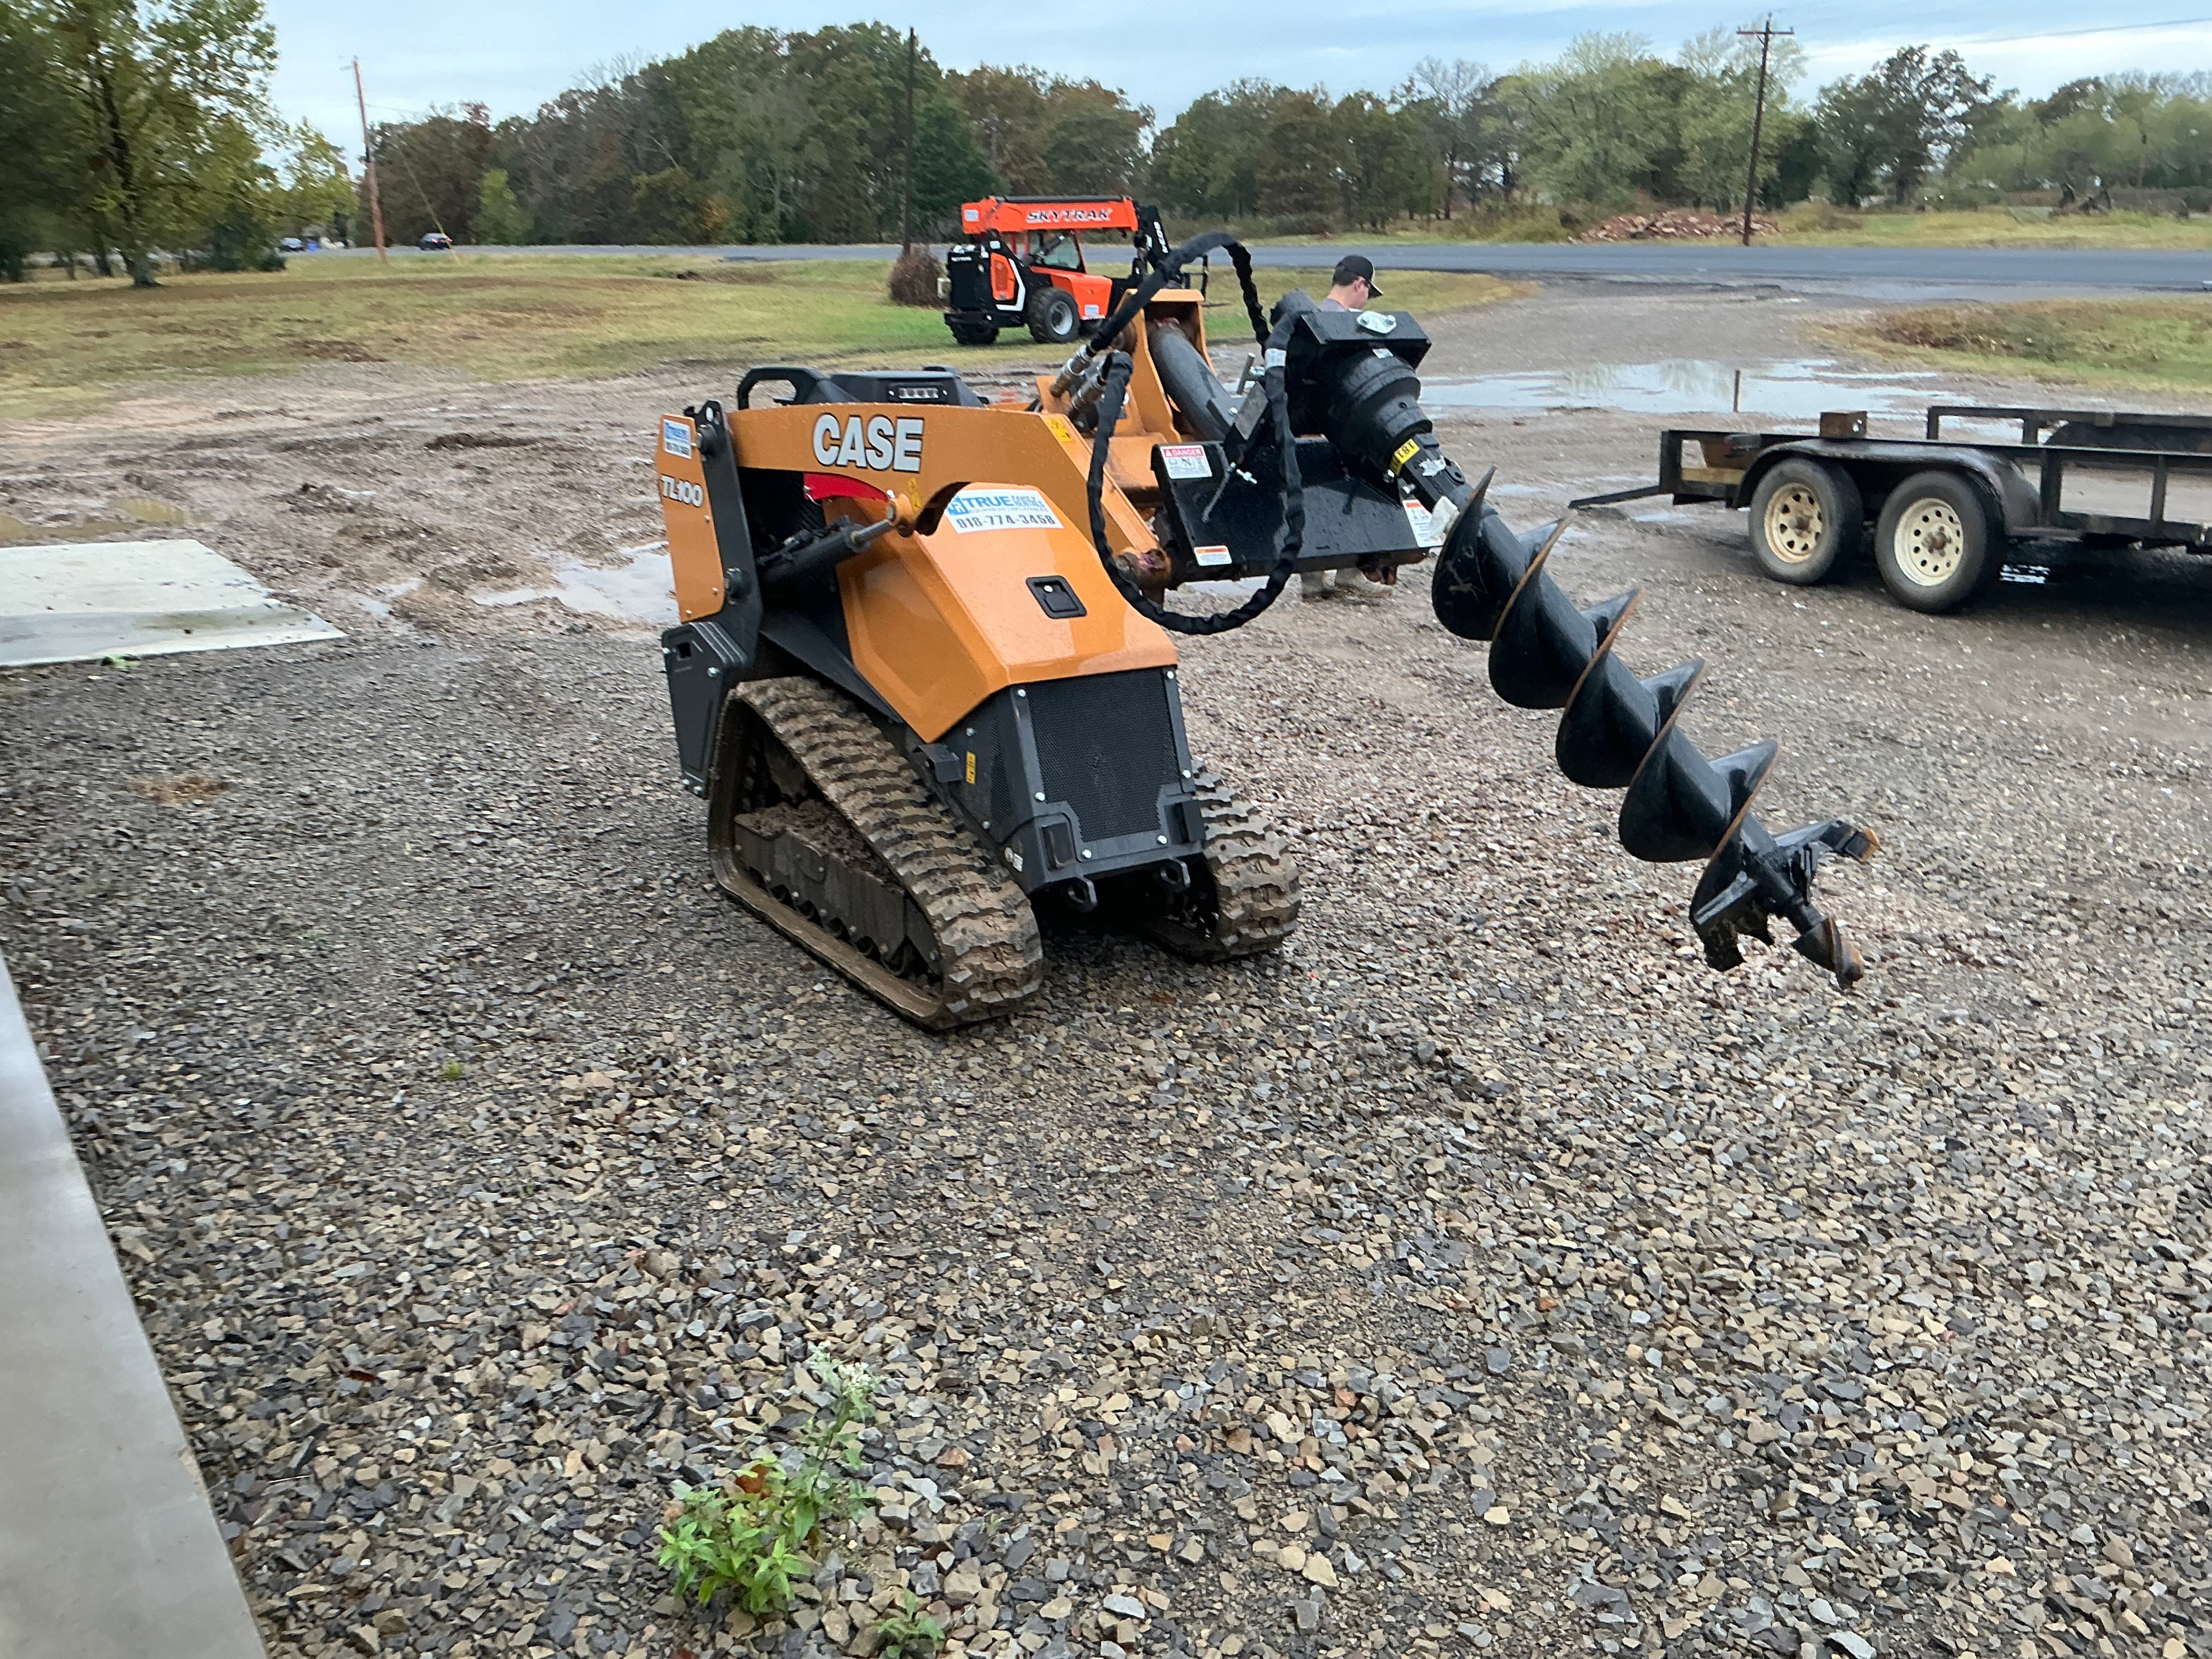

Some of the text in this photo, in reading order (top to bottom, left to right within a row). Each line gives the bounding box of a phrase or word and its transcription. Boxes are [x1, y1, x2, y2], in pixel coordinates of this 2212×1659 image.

[1026, 208, 1113, 223] SKYTRAK
[812, 413, 924, 473] CASE
[661, 473, 703, 507] TL100
[962, 496, 1015, 508] TRUE
